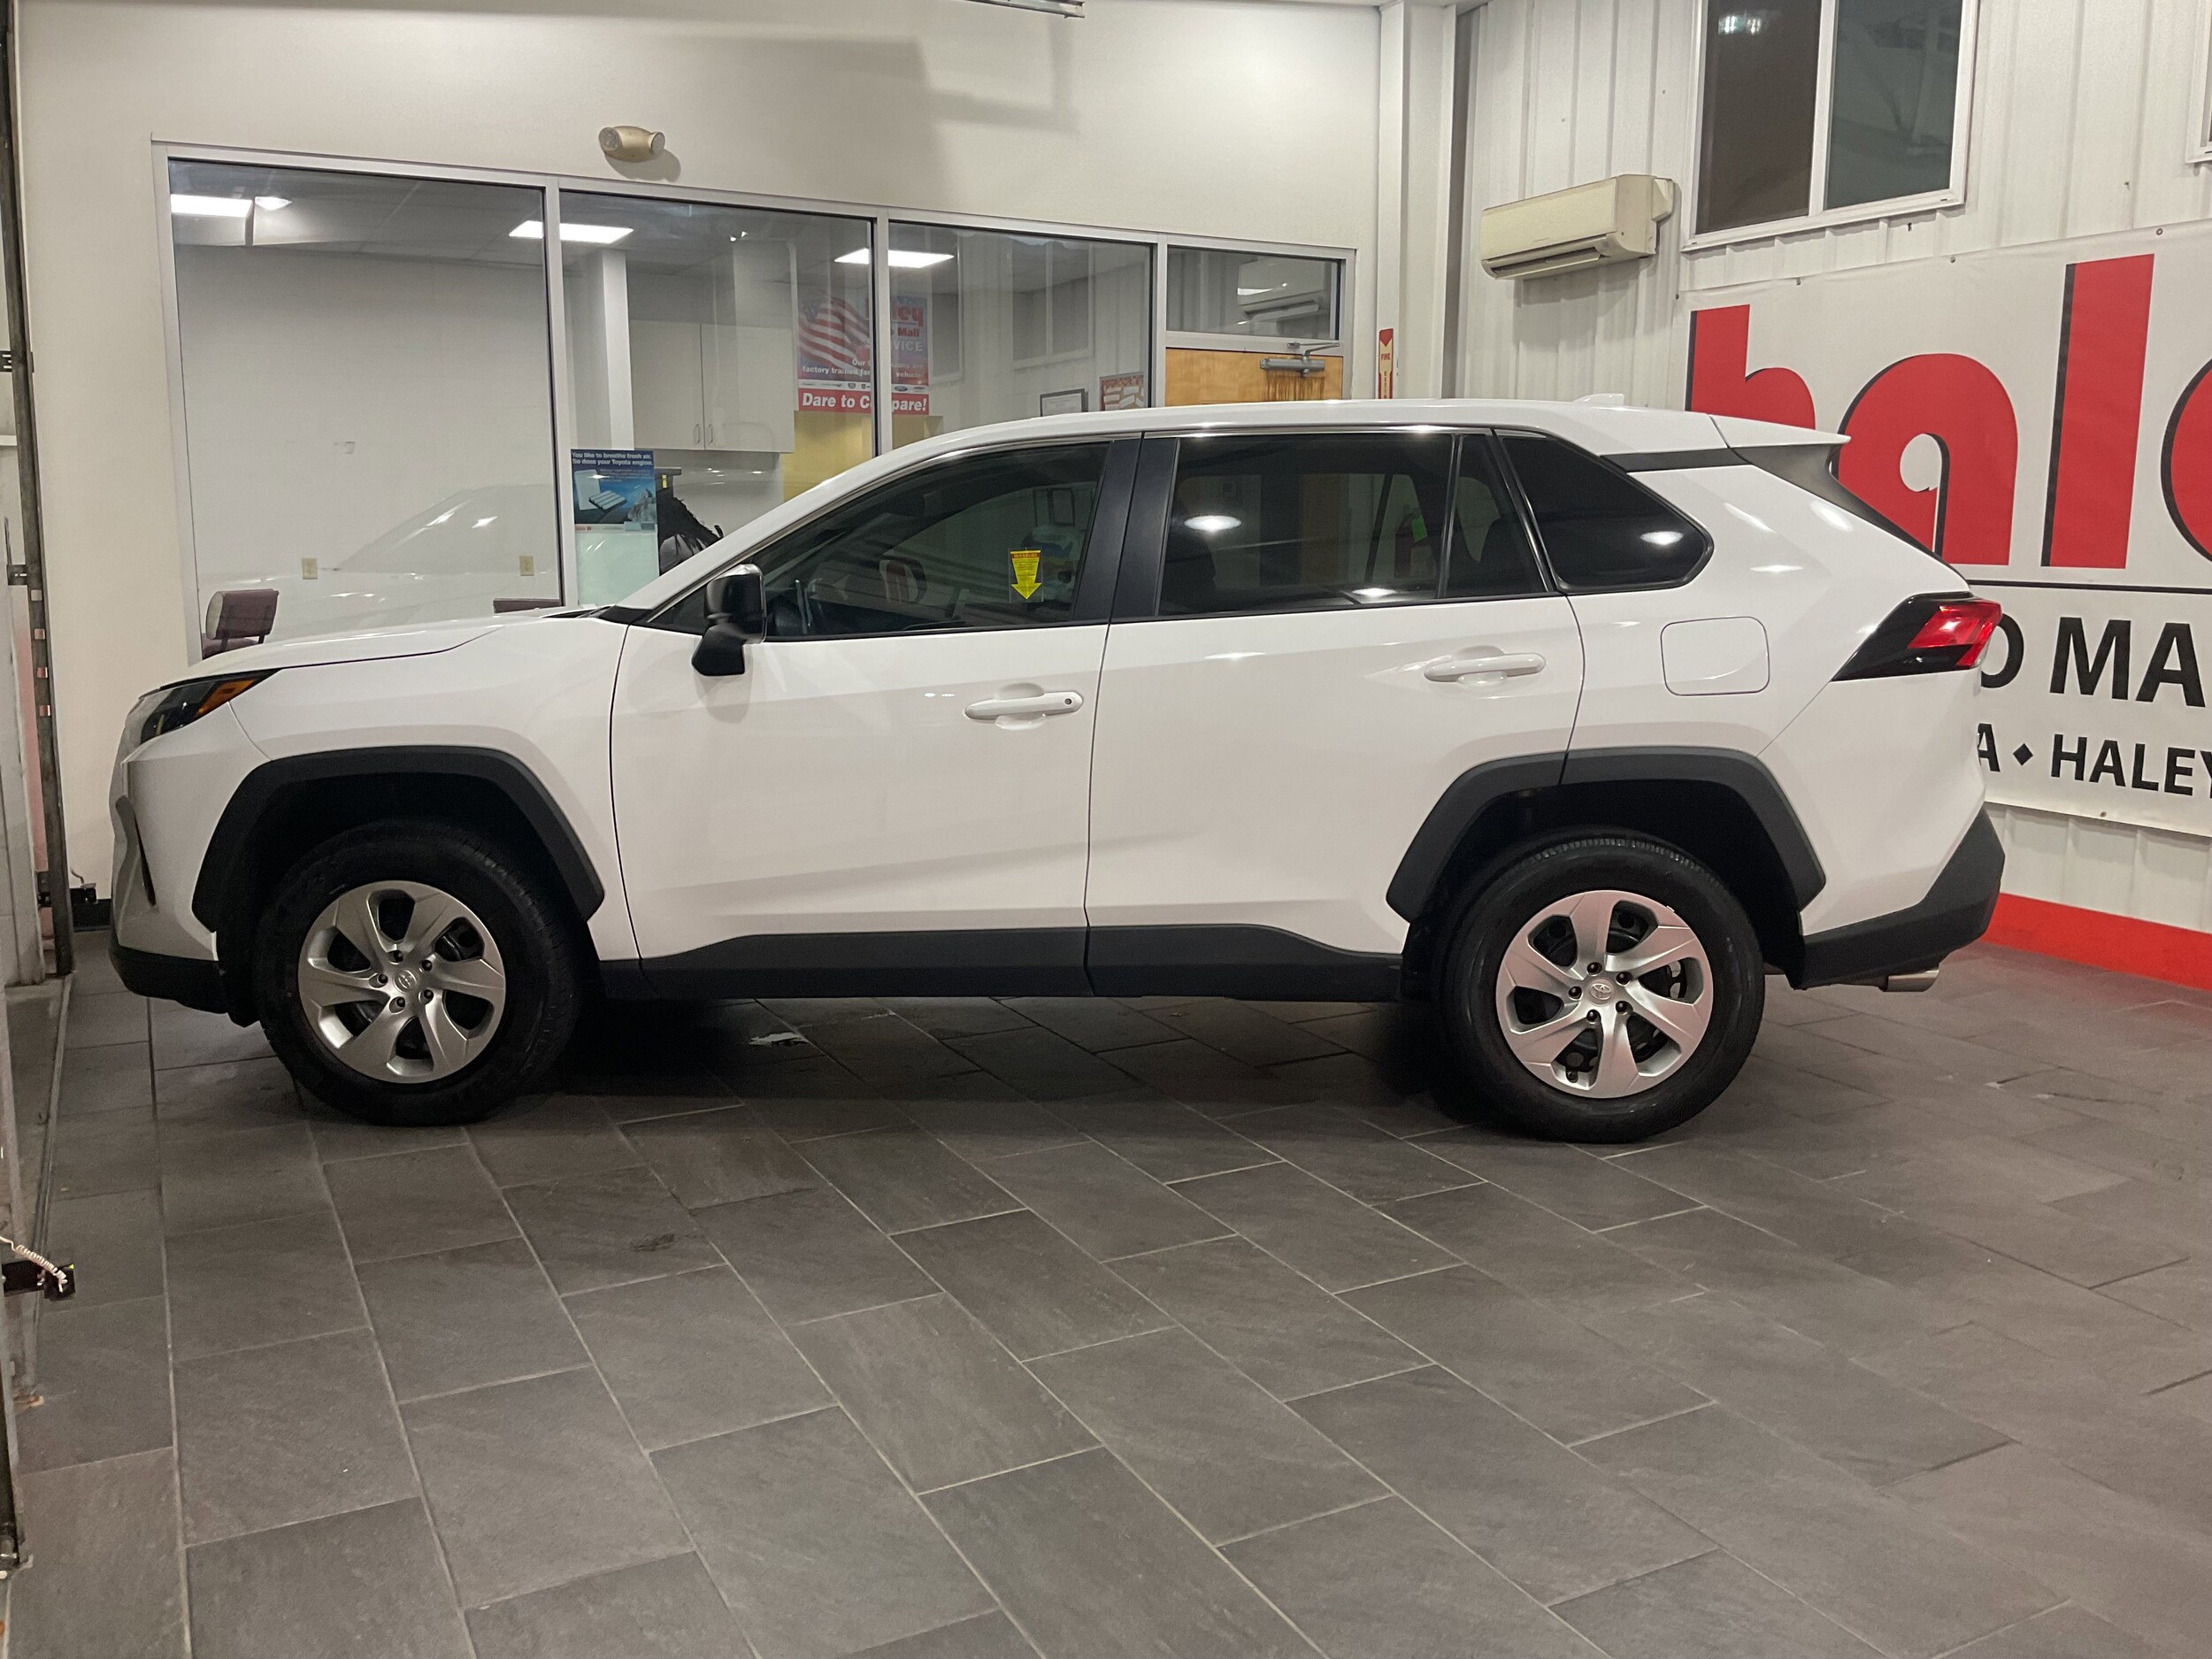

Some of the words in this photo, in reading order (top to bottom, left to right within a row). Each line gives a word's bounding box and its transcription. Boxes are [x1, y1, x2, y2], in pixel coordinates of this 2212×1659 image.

[897, 326, 919, 337] Mall
[893, 341, 923, 351] VICE
[803, 365, 829, 374] factory
[803, 392, 836, 407] Dare
[841, 395, 856, 408] to
[859, 395, 926, 411] Cpare!
[2049, 616, 2207, 708] MA
[2050, 733, 2212, 799] HALE
